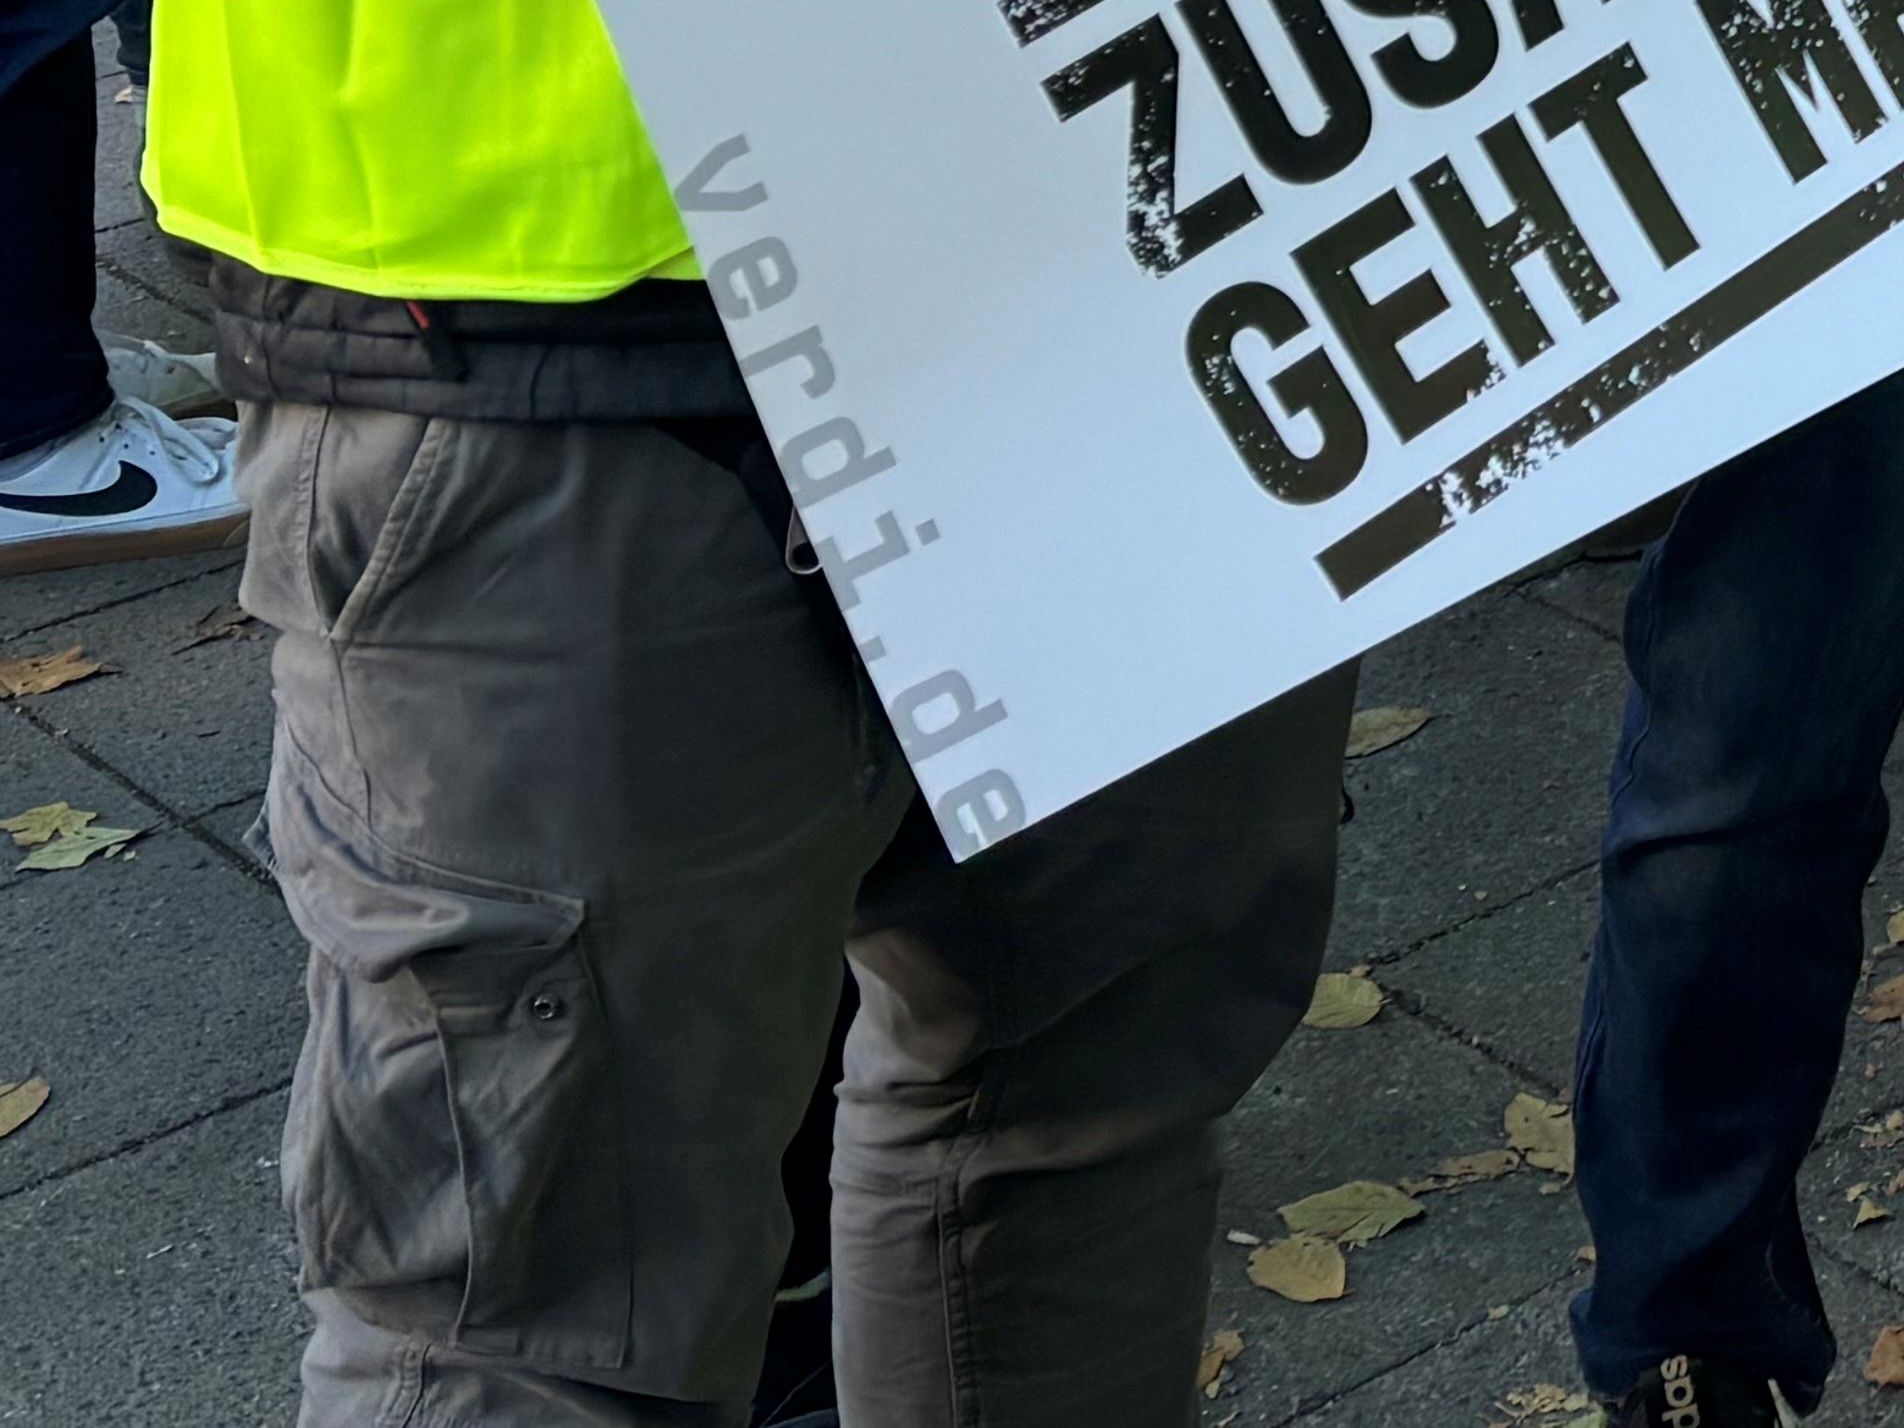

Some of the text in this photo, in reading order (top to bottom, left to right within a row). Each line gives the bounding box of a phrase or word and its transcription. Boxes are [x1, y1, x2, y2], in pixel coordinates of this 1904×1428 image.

[673, 133, 1027, 854] verdi.de
[1182, 43, 1701, 507] GEHT
[1661, 1354, 1700, 1428] das
